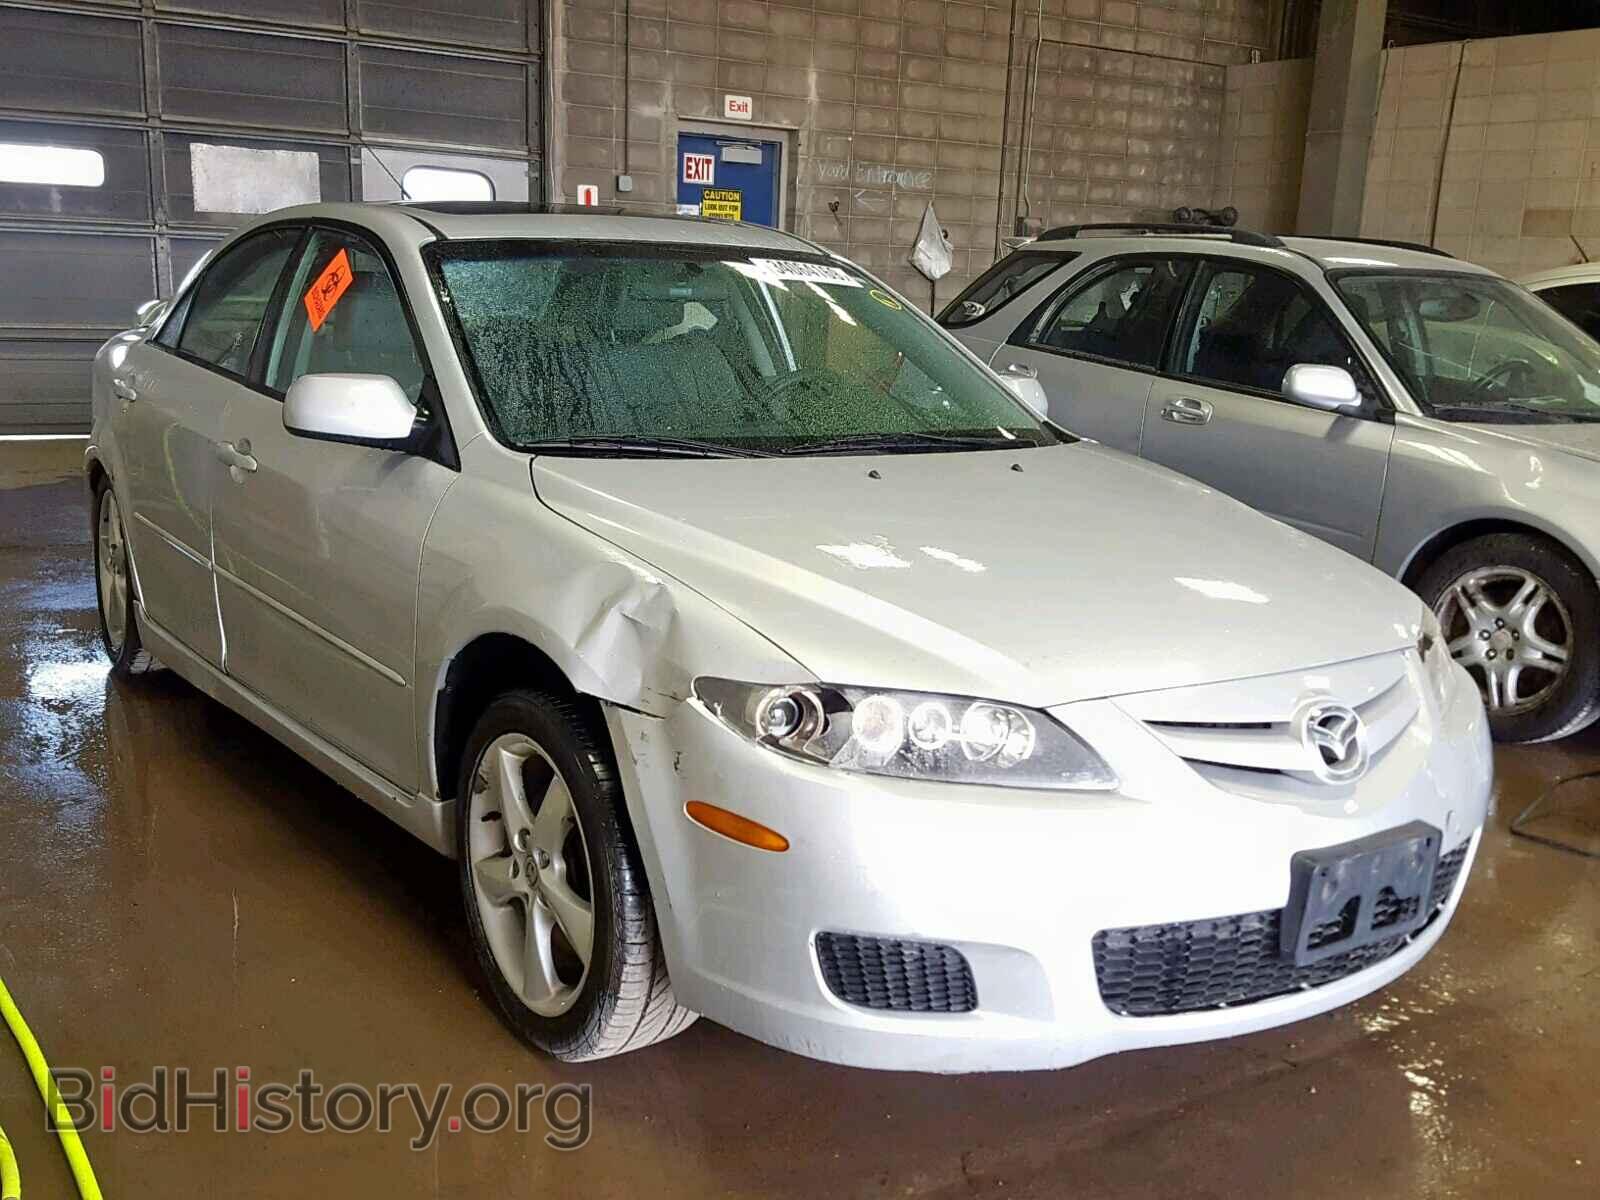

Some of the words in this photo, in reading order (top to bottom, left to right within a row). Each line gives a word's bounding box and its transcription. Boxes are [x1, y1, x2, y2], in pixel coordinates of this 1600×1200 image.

[729, 100, 748, 113] Exit
[685, 156, 712, 181] EXIT
[704, 190, 740, 200] CAUTION
